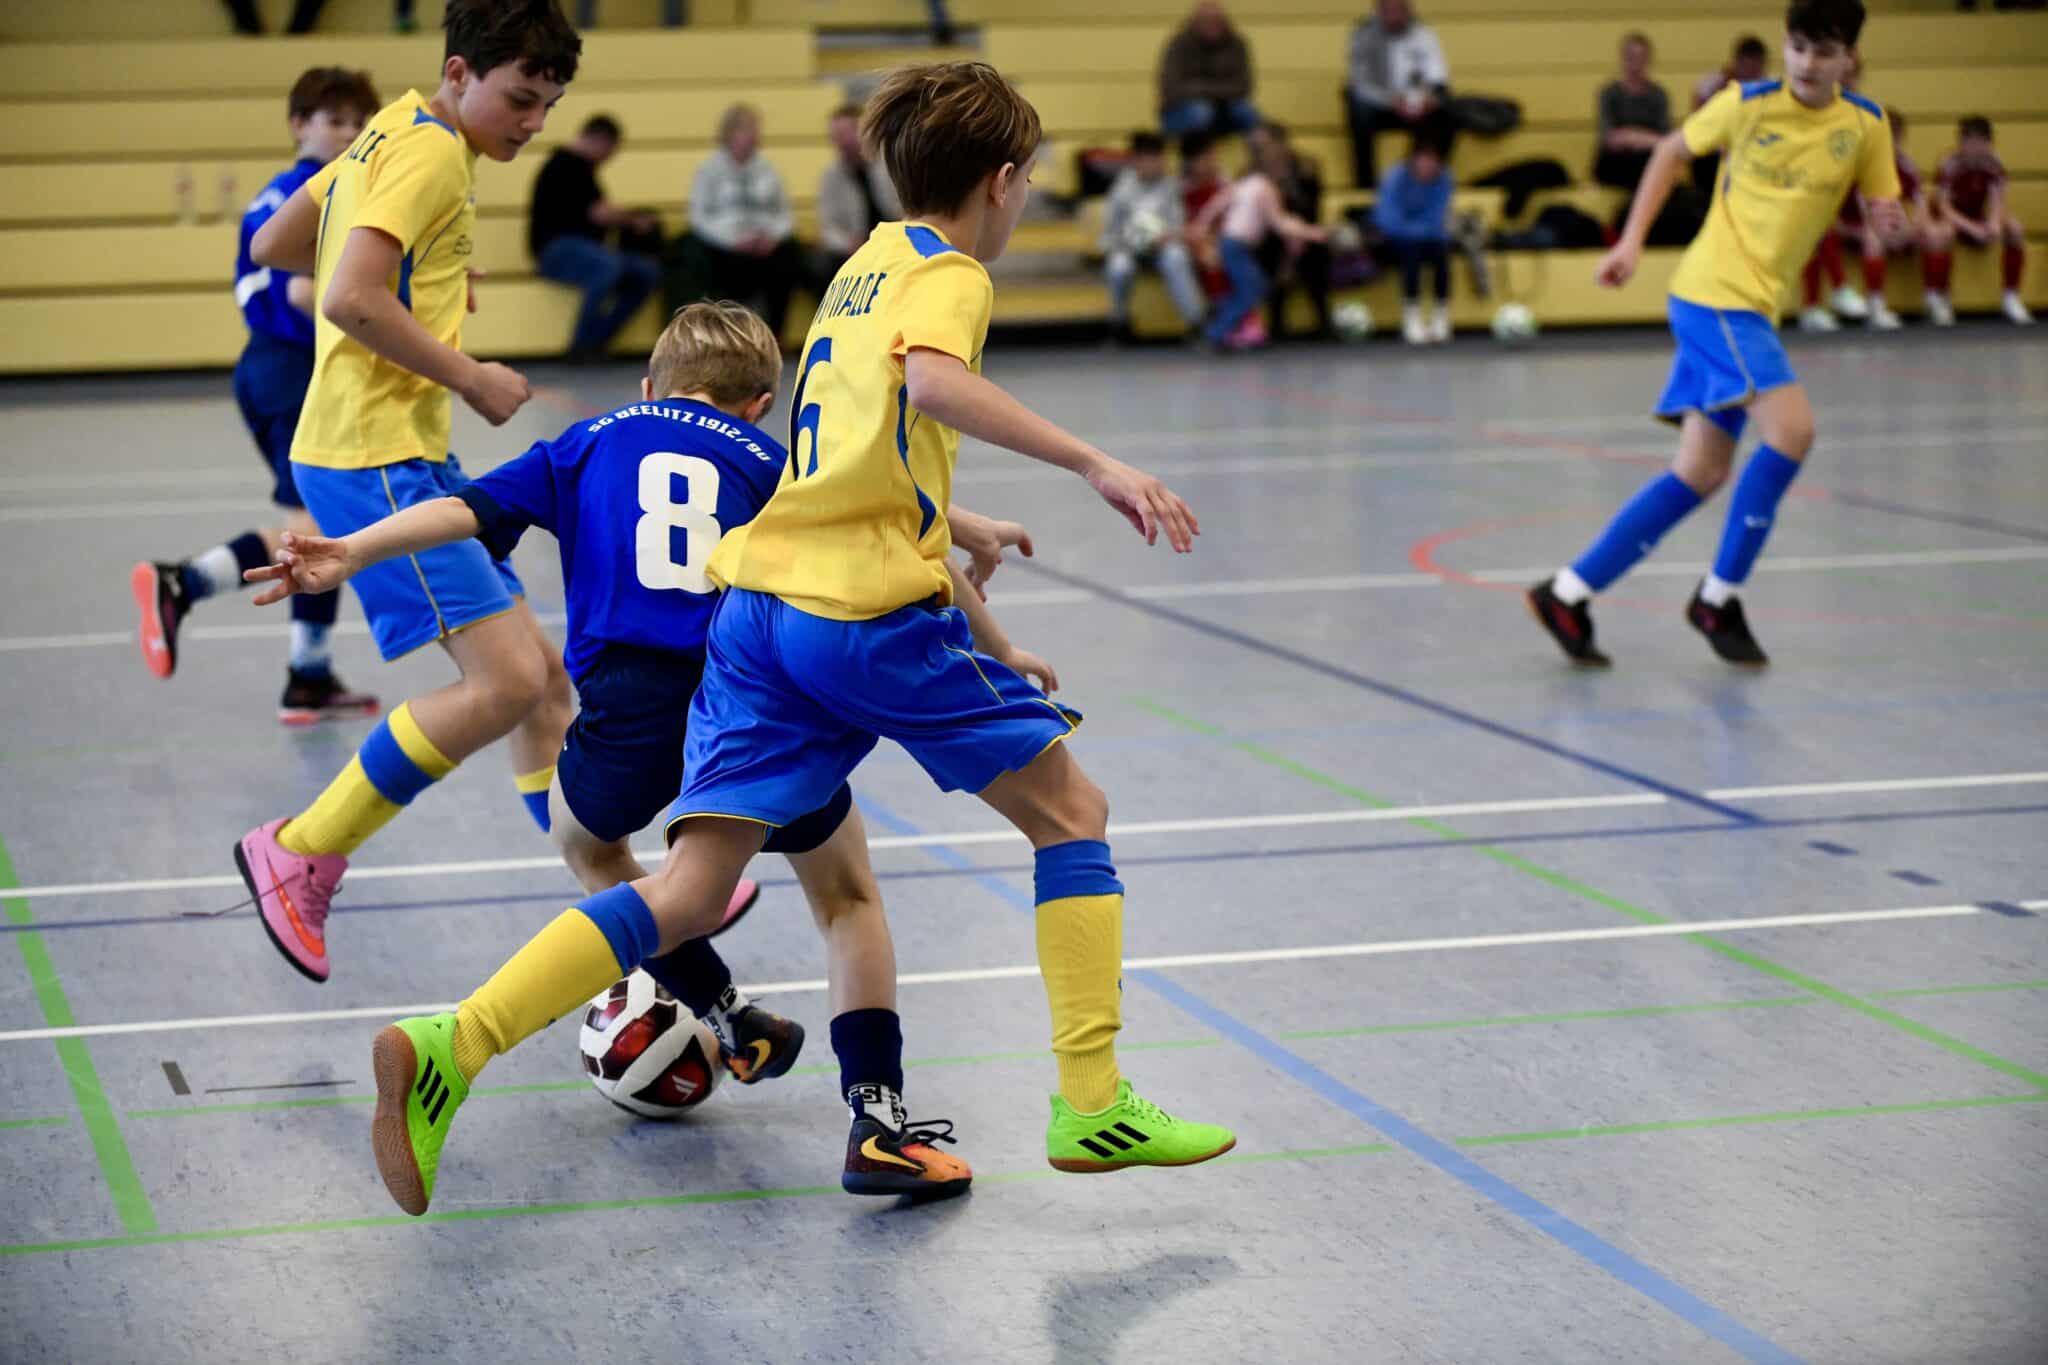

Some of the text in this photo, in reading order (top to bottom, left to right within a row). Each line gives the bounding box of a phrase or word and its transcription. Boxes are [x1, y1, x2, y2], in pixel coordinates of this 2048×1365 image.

[588, 417, 615, 433] SG
[614, 405, 695, 424] BEELITZ
[635, 451, 722, 595] 8
